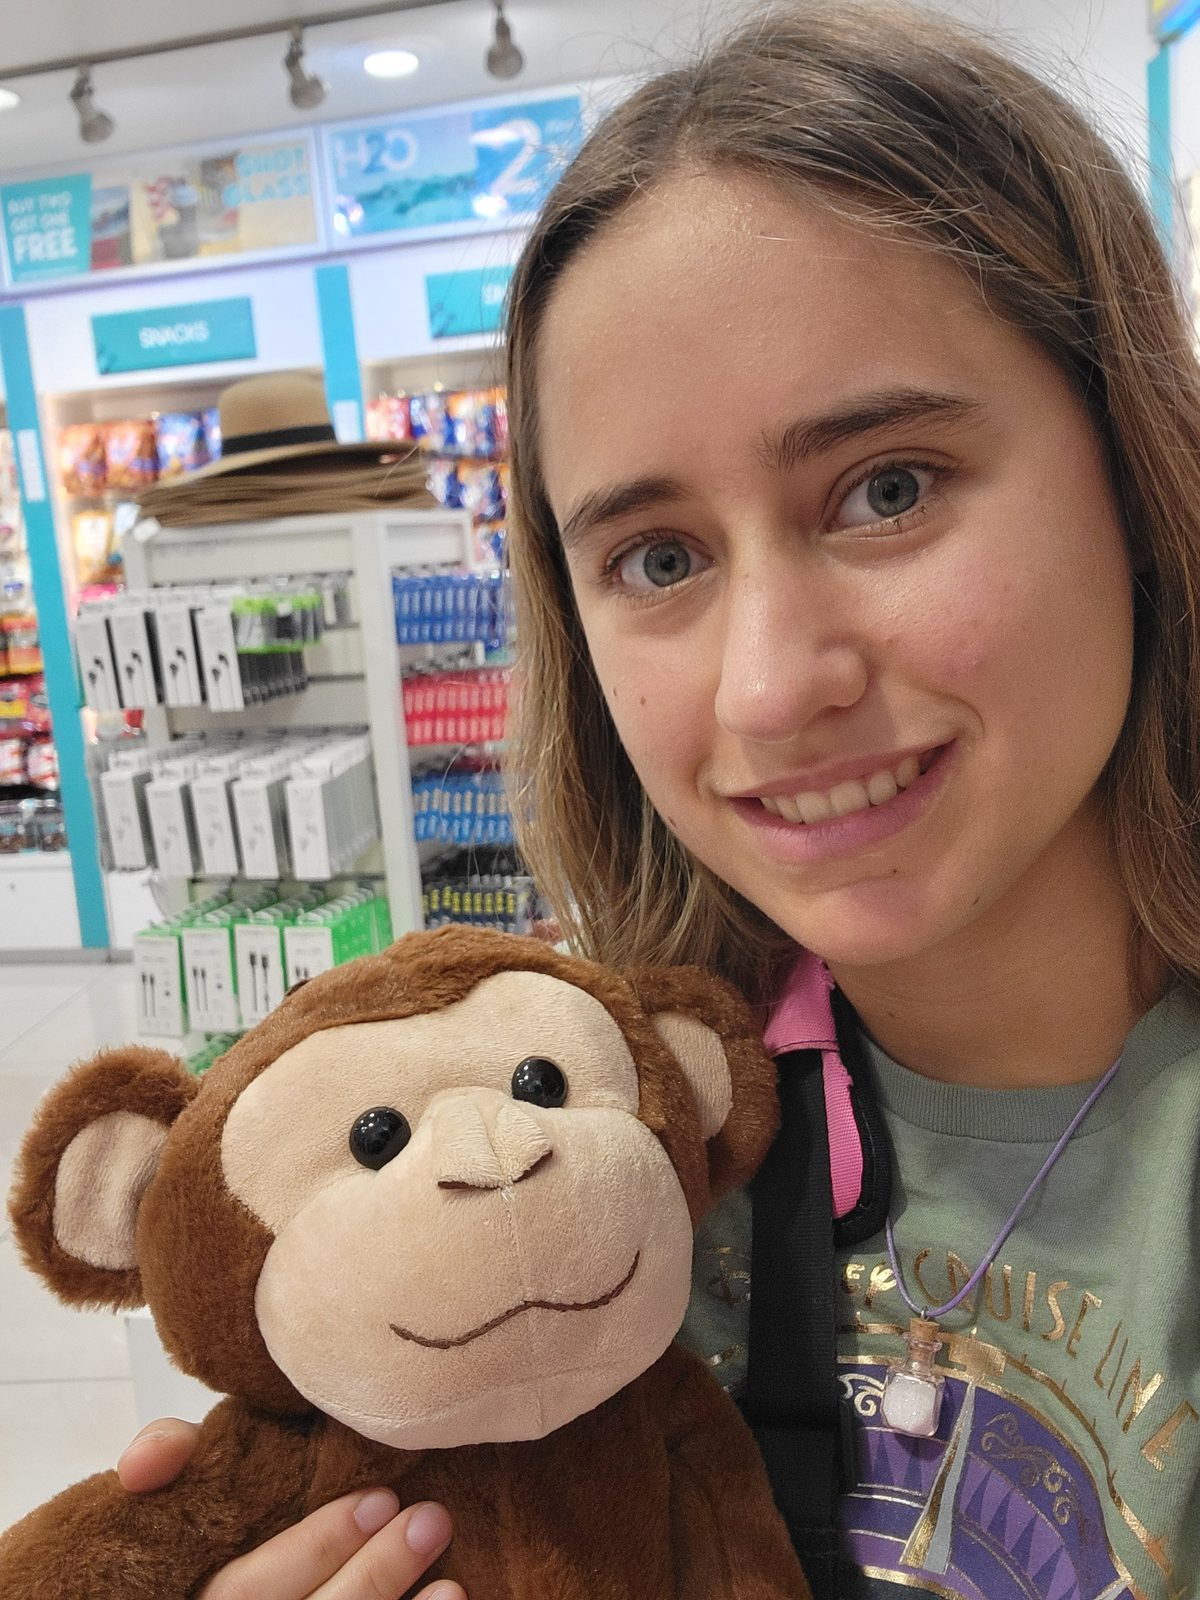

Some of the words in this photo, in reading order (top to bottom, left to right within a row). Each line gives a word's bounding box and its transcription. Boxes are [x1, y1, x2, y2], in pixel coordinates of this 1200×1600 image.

[13, 228, 78, 264] FREE
[139, 321, 209, 349] SNACKS
[913, 1247, 1103, 1360] CRUISE
